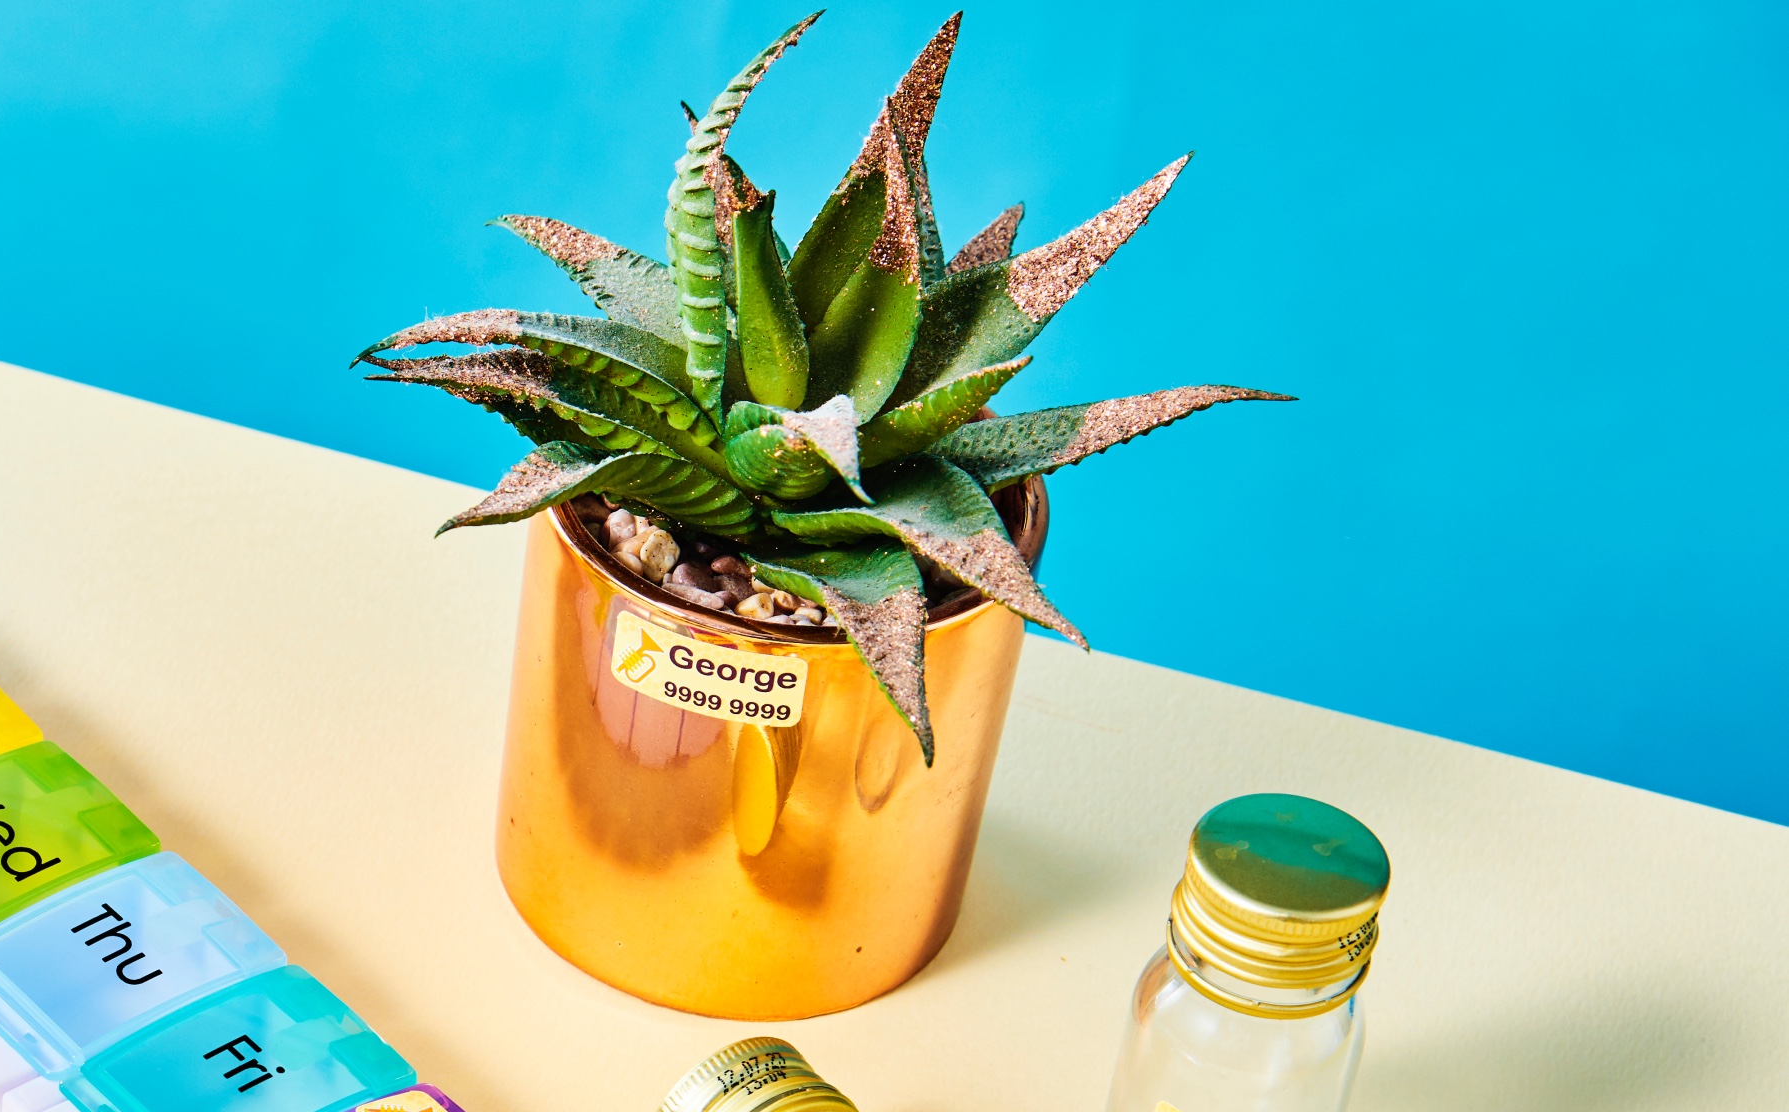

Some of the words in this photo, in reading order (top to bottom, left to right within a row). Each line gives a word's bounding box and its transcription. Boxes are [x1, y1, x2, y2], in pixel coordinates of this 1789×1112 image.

[669, 645, 798, 693] George
[665, 681, 721, 710] 9999
[730, 699, 790, 720] 9999
[70, 903, 163, 985] Thu
[203, 1034, 285, 1093] Fri
